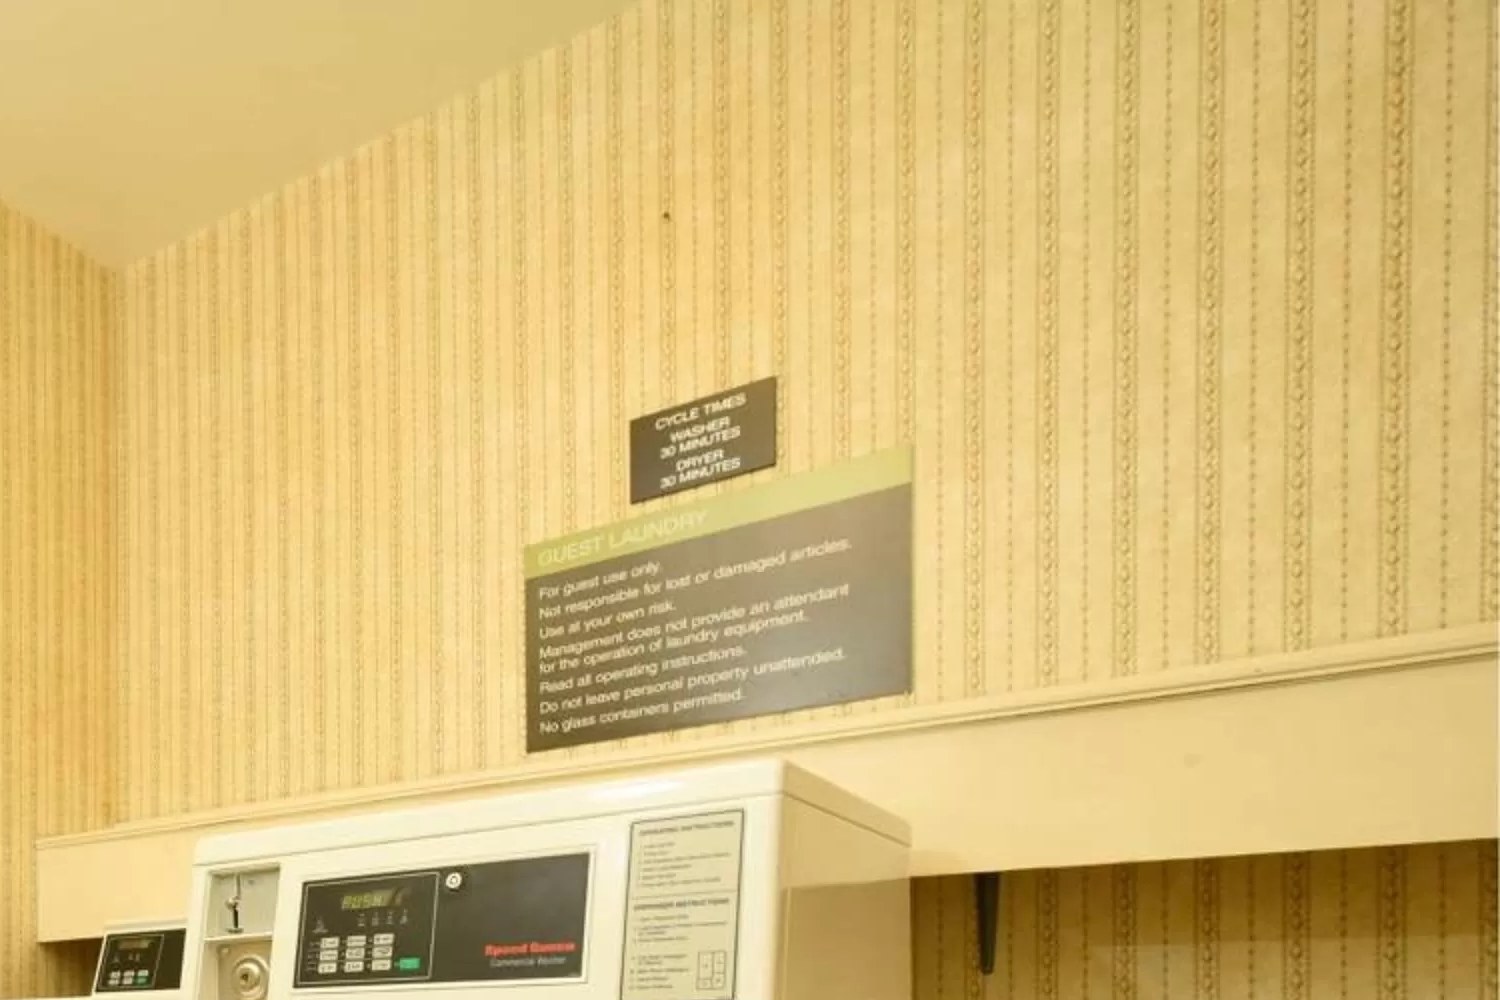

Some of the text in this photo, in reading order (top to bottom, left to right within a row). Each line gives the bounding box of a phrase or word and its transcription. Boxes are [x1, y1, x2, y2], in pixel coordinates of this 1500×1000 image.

[655, 393, 746, 430] CYCLE TIMES
[670, 416, 731, 442] WASHER
[660, 426, 741, 459] 30 MINUTES
[676, 448, 724, 472] DRYER
[660, 457, 741, 489] 30 MINUTES
[538, 510, 709, 566] GUEST LAUNDRY
[540, 538, 852, 619] Not responsible for lost or damaged articles.
[540, 586, 559, 599] For
[563, 575, 599, 596] guest
[603, 570, 628, 584] use
[540, 599, 676, 639] Use at your own risk.
[540, 583, 849, 659] Management does not provide an attendant
[540, 660, 555, 674] for
[559, 656, 580, 670] the
[583, 644, 645, 666] operation
[649, 637, 663, 652] of
[665, 628, 719, 649] laundry
[540, 678, 573, 694] Read
[577, 673, 592, 688] all
[595, 662, 658, 685] operating
[540, 701, 558, 715] Do
[562, 696, 583, 711] not
[585, 690, 620, 706] leave
[624, 676, 684, 701] personal
[687, 665, 749, 691] property
[540, 721, 558, 736] No
[561, 715, 596, 733] glass
[599, 701, 669, 724] containers
